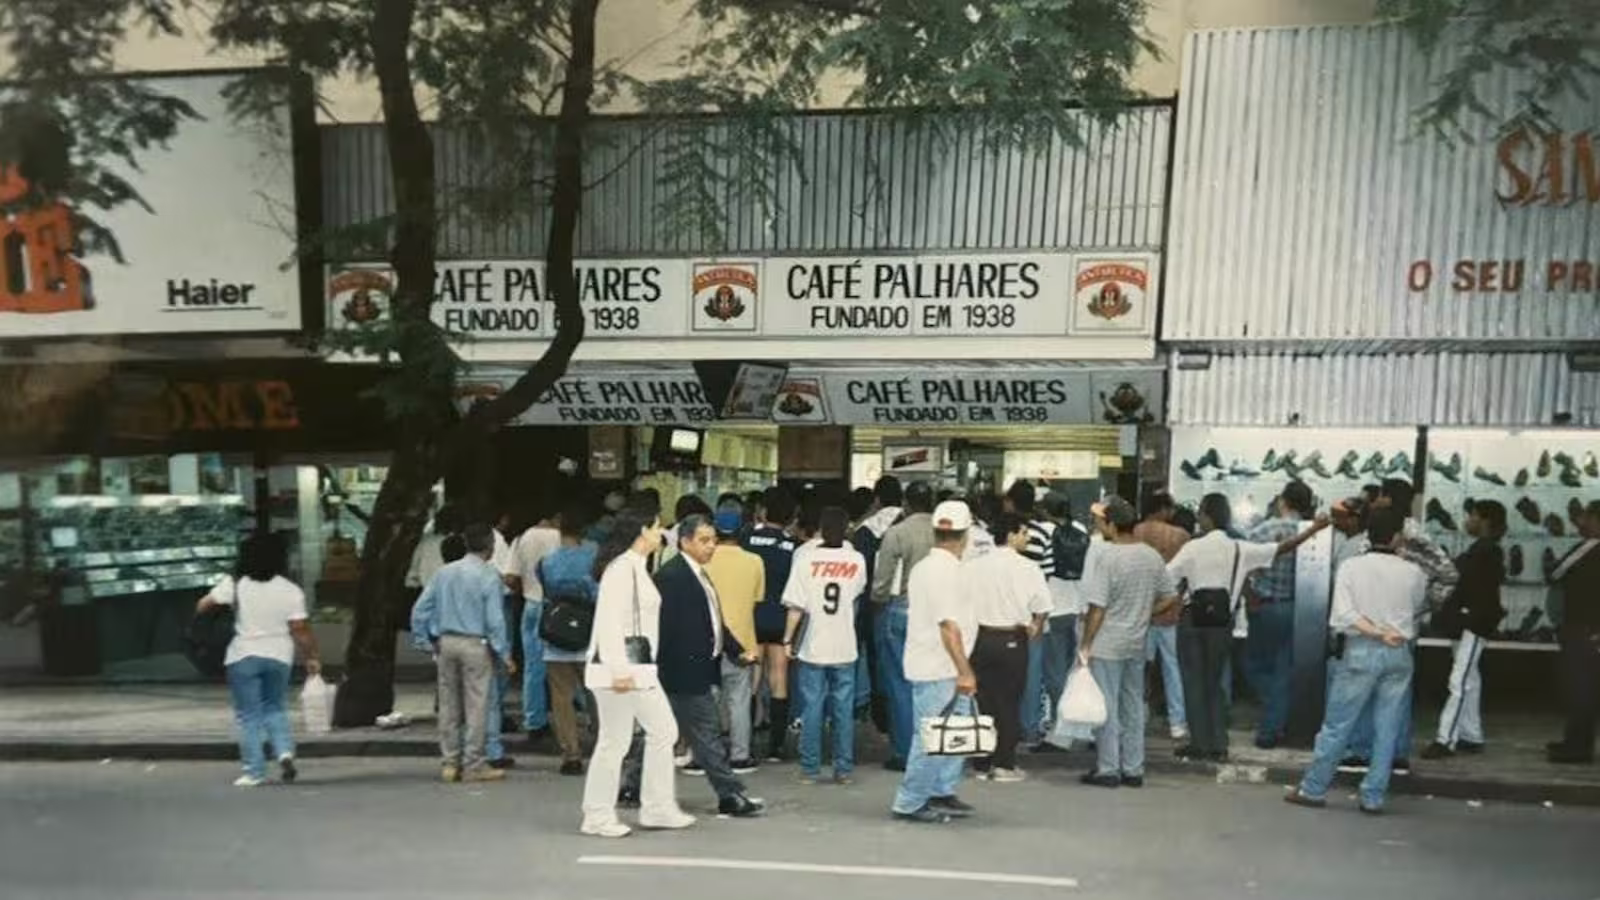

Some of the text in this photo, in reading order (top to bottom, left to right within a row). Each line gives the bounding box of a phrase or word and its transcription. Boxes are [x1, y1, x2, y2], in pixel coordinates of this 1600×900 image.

[434, 264, 493, 302] AFÉ
[504, 266, 662, 303] PAARES
[787, 259, 1040, 300] CAFÉ PALHARES
[1408, 259, 1600, 293] O SEU PR
[167, 278, 255, 306] Haier
[445, 308, 540, 332] FUNDADO
[589, 306, 641, 330] 1938
[811, 304, 1016, 329] FUNDADO EM 1938
[600, 380, 704, 404] PALHAR
[846, 377, 911, 404] CAFÉ
[922, 379, 1067, 404] PALHARES
[558, 406, 715, 422] FUNDADO EM 193
[873, 405, 1049, 422] FUNDADO EM 1938
[811, 561, 859, 579] TAM
[823, 582, 840, 616] 9
